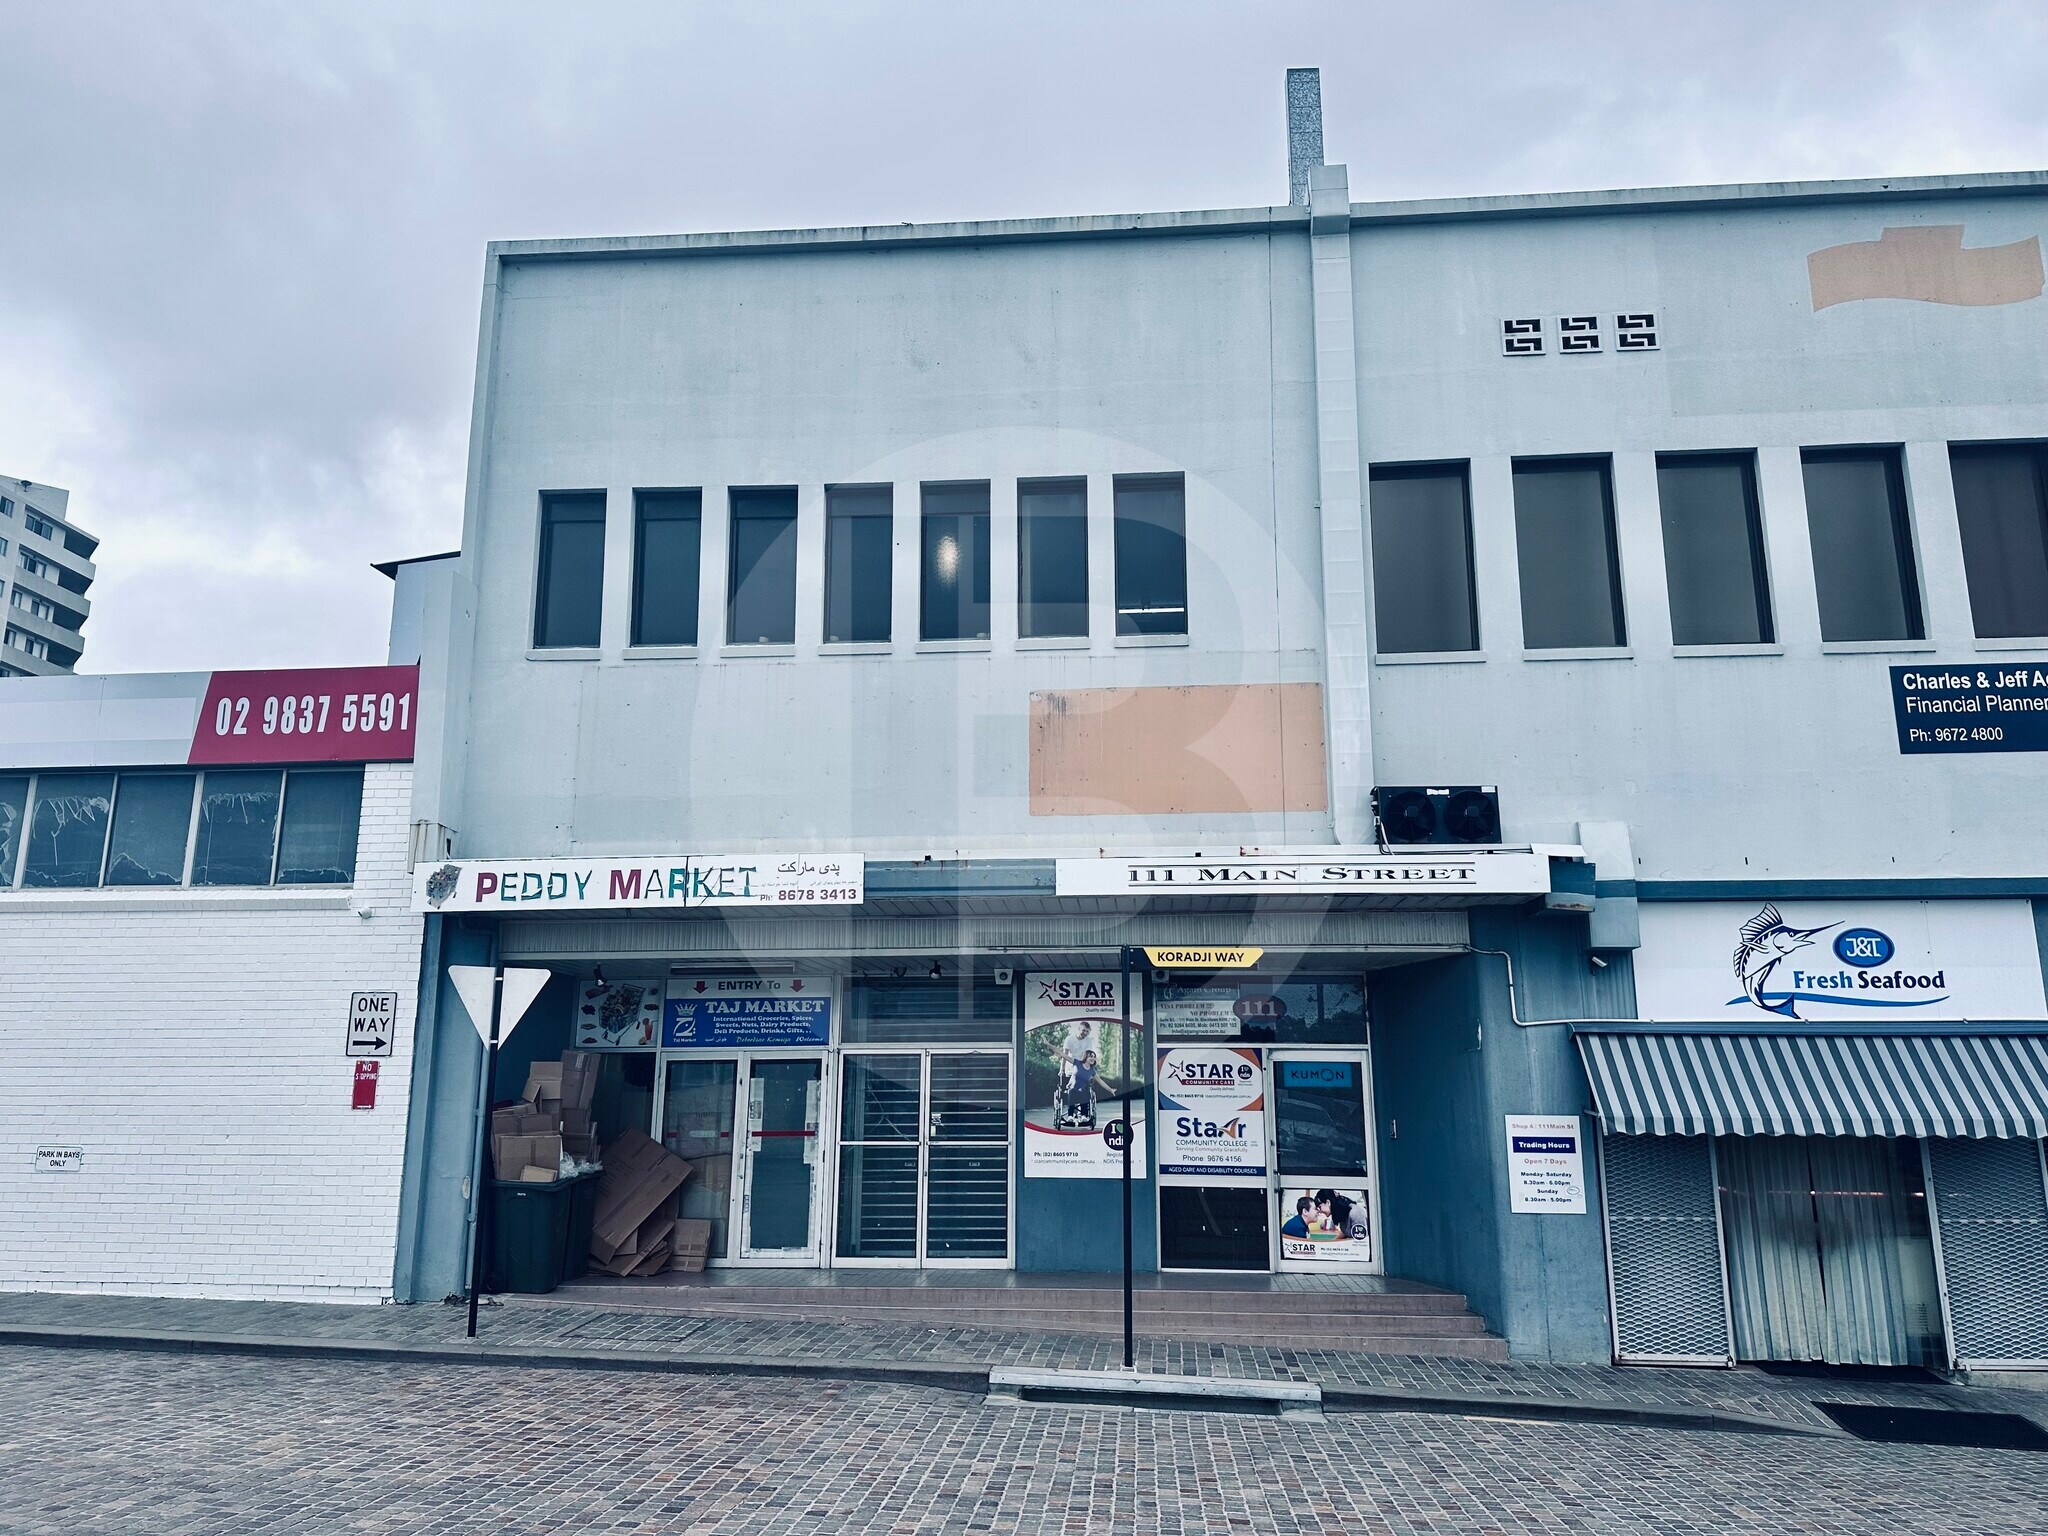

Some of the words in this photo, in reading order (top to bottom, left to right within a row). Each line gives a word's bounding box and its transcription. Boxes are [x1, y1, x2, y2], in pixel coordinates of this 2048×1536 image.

[1903, 673, 1972, 689] Charles
[1976, 672, 1991, 689] &
[1995, 671, 2028, 688] Jeff
[1906, 695, 1981, 713] Financial
[215, 697, 250, 736] 02
[262, 695, 331, 735] 9837
[341, 692, 411, 733] 5591
[1910, 728, 1932, 742] Ph:
[1935, 728, 1968, 741] 9672
[1971, 727, 2003, 741] 4800
[1128, 869, 1176, 882] 111
[475, 870, 593, 902] PEDDY
[608, 866, 757, 900] MARKET
[760, 894, 773, 902] Ph:
[778, 889, 815, 901] 8678
[820, 888, 857, 900] 3413
[1845, 937, 1882, 957] J&T
[1157, 952, 1211, 962] KORADJI
[1215, 952, 1245, 962] WAY
[718, 980, 763, 991] ENTRY
[767, 981, 781, 990] To
[1793, 970, 1853, 989] Fresh
[1858, 970, 1945, 989] Seafood
[1058, 982, 1114, 999] STAR
[358, 998, 390, 1012] ONE
[705, 1001, 744, 1014] TAJ
[745, 1000, 825, 1014] MARKET
[1242, 1001, 1278, 1016] 111
[354, 1017, 390, 1032] WAY
[362, 1063, 372, 1072] NO
[1185, 1064, 1233, 1078] STAR
[1291, 1069, 1344, 1081] KUMON
[1108, 1135, 1124, 1146] ndi
